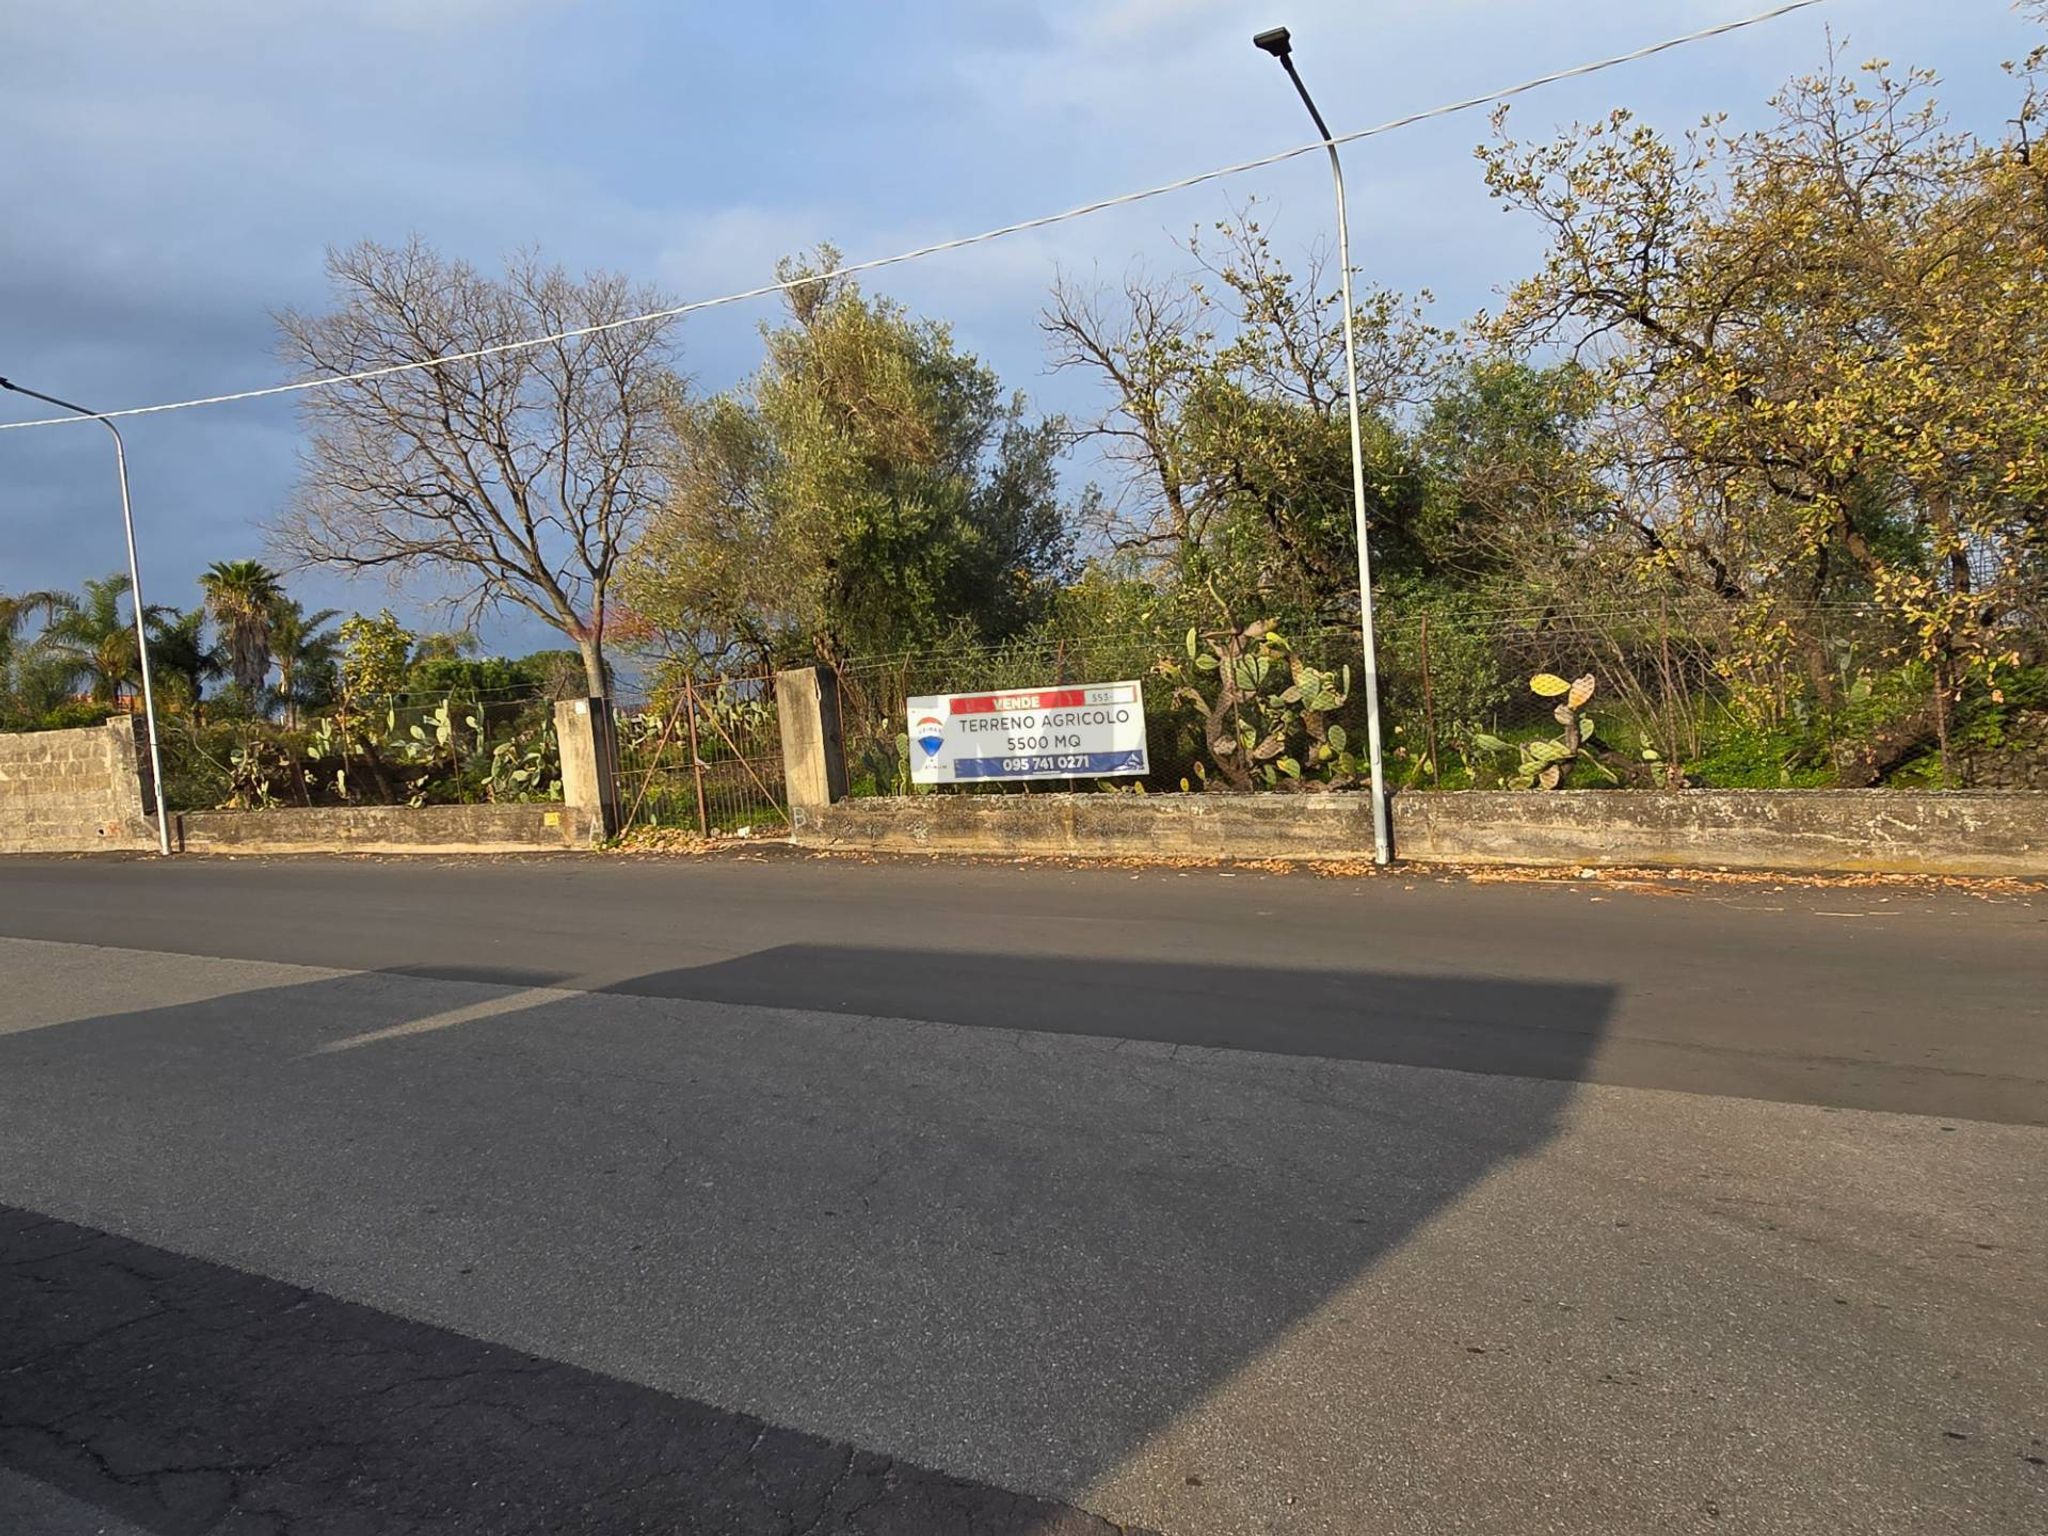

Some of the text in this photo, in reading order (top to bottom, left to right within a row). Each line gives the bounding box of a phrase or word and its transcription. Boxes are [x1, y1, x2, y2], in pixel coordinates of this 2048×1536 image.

[993, 696, 1041, 711] VENDE
[959, 709, 1130, 732] TERRENO AGRICOLO
[1007, 734, 1082, 751] 5500 MQ
[1002, 755, 1090, 771] 095 741 0271
